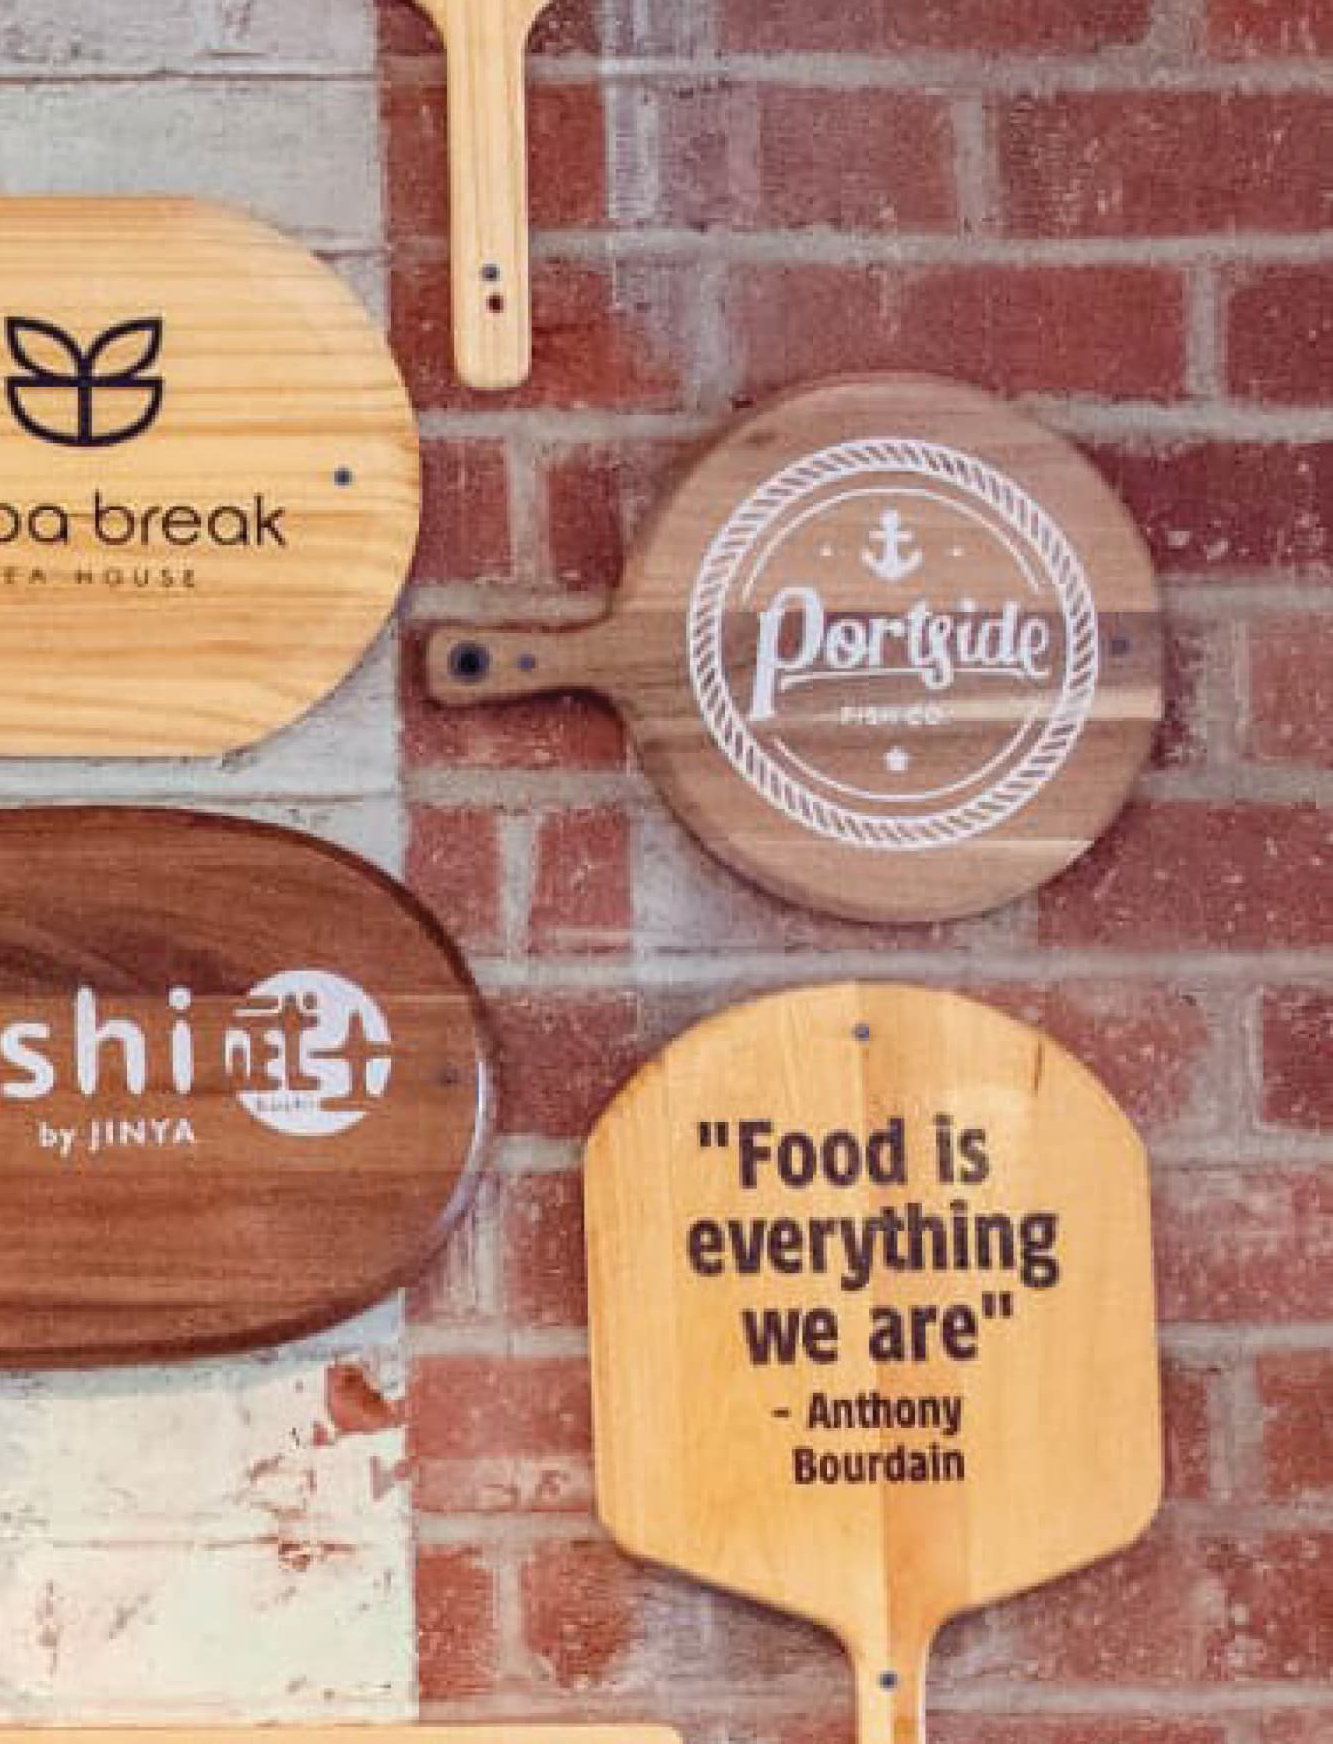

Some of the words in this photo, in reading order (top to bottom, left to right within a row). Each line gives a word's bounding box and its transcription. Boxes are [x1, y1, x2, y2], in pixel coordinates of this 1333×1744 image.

[94, 488, 289, 547] break
[75, 566, 197, 589] HOUSE
[748, 585, 1055, 723] Portside
[38, 1121, 75, 1155] by
[89, 1118, 195, 1151] JINYA
[697, 1116, 910, 1190] "Food
[933, 1112, 991, 1185] is
[686, 1199, 1061, 1291] everything
[741, 1307, 839, 1366] we
[868, 1291, 1014, 1365] are"
[807, 1393, 963, 1435] Anthony
[792, 1444, 966, 1485] Bourdain
